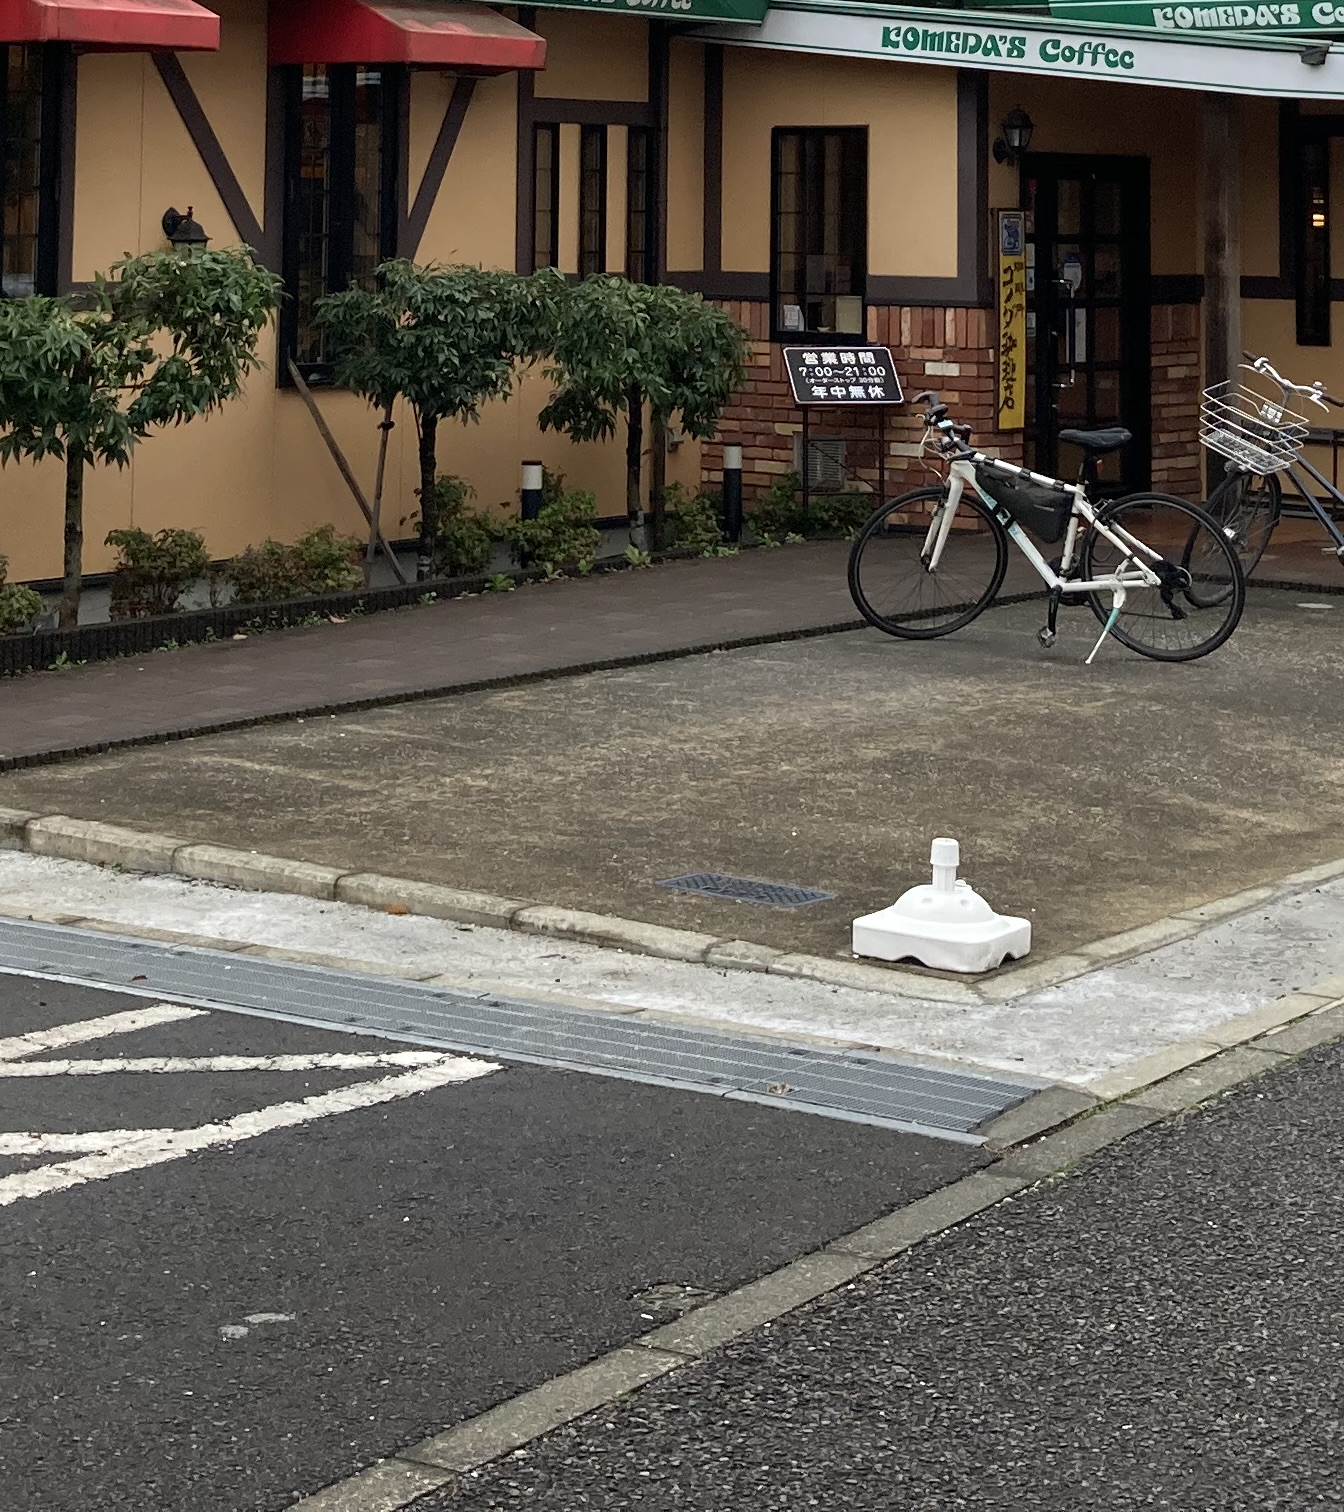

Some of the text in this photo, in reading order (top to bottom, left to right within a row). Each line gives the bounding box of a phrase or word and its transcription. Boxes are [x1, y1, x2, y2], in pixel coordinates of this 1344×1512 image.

[1153, 3, 1301, 29] KOMEDA'S
[881, 26, 1134, 70] KOMEDA'S Coffee
[802, 351, 876, 365] 営業時間
[811, 385, 886, 399] 年中無休
